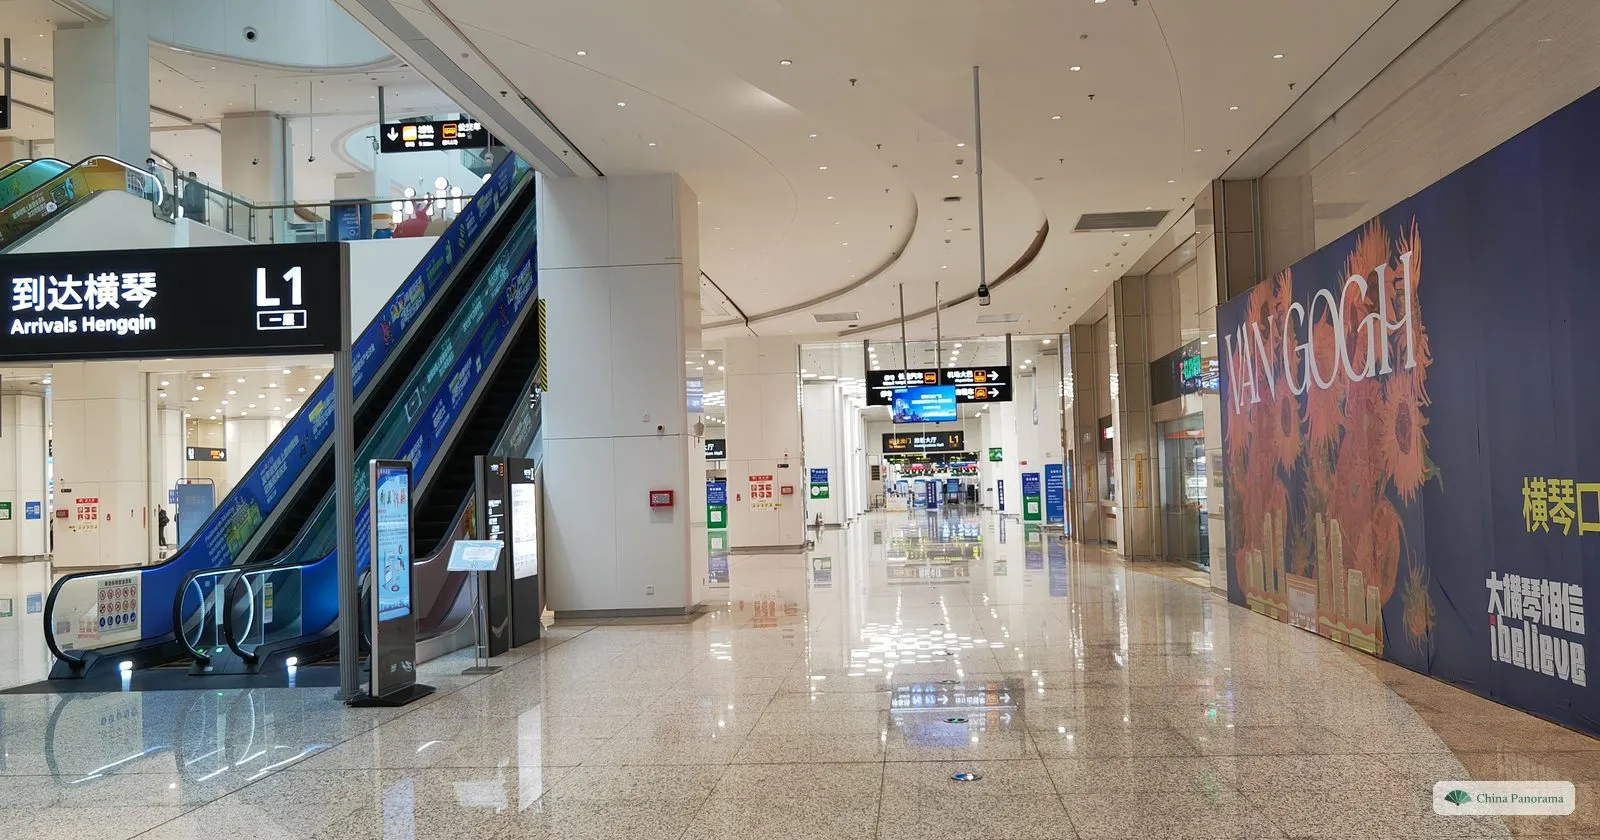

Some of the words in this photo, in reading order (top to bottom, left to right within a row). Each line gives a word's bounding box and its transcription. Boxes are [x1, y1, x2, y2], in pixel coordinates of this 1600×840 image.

[11, 271, 158, 312] 到达横琴
[256, 266, 302, 307] L1
[10, 316, 78, 335] Arrivals
[82, 313, 156, 335] Hengqin
[1224, 315, 1276, 415] VAN
[1283, 250, 1416, 396] GOGH
[1522, 476, 1600, 536] 横琴口
[1485, 571, 1585, 635] 大横琴相信
